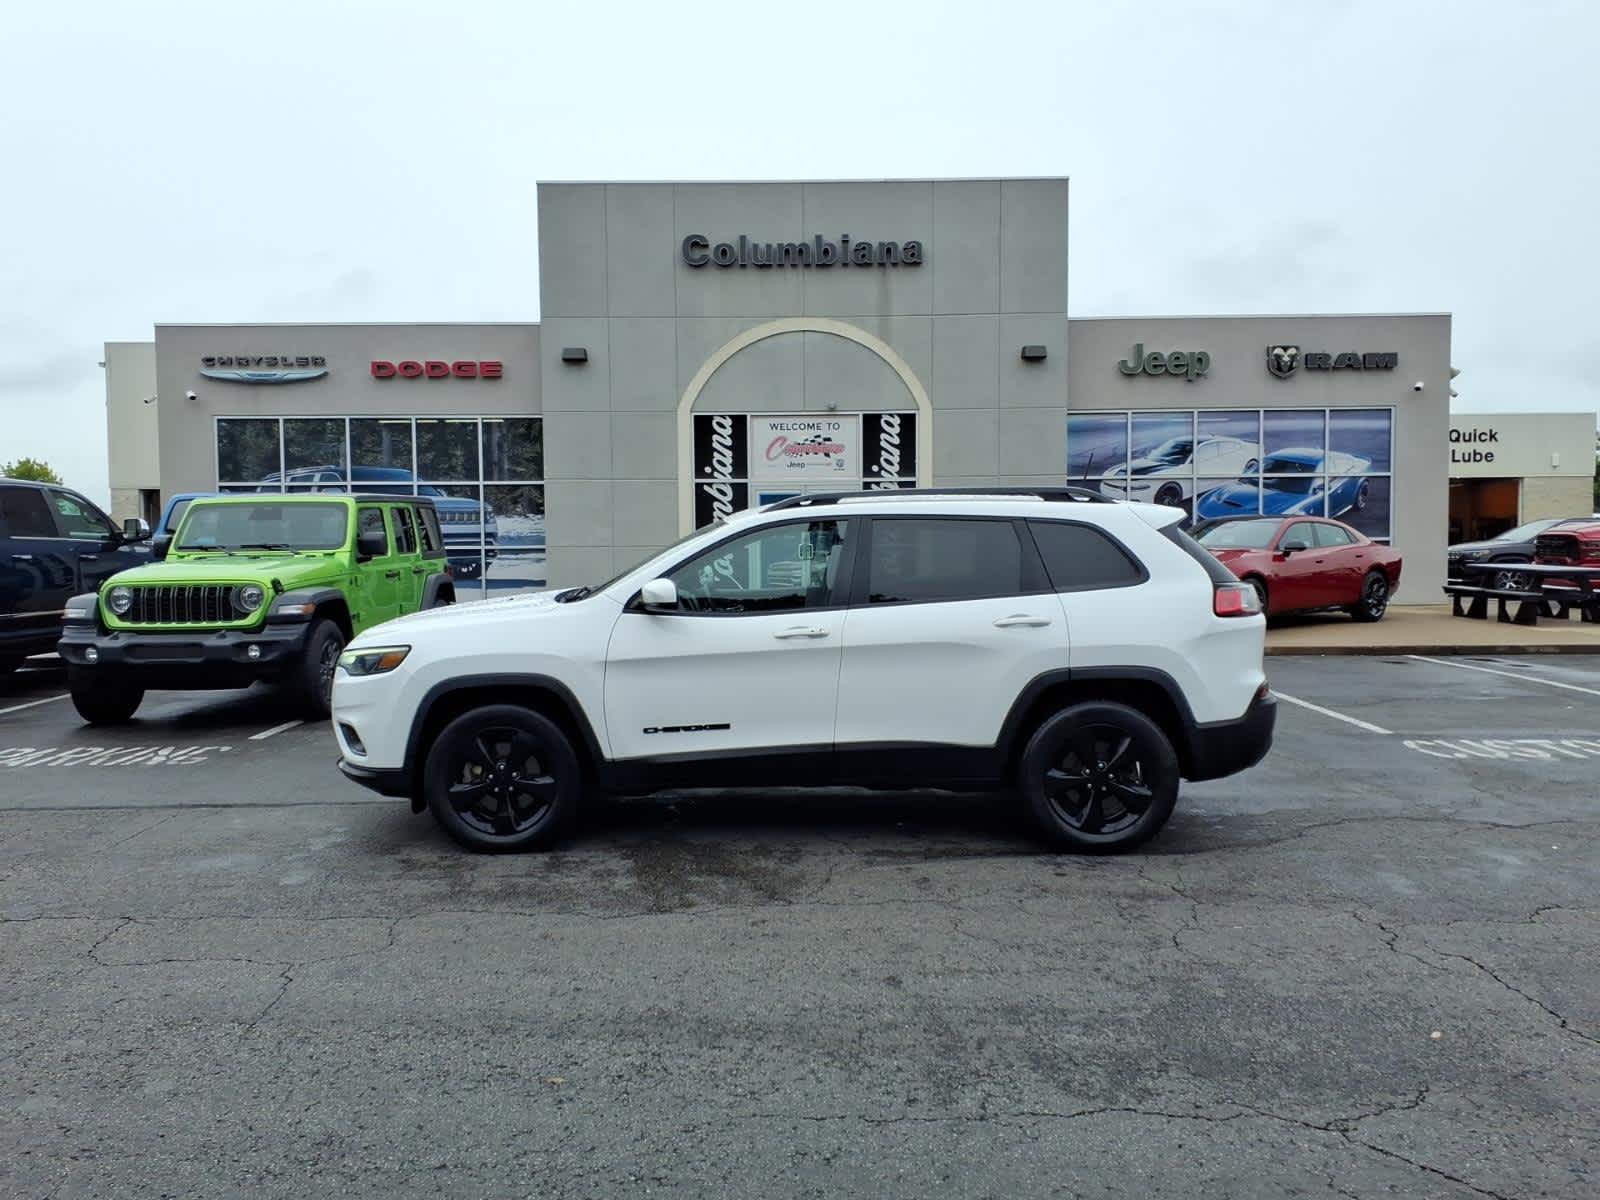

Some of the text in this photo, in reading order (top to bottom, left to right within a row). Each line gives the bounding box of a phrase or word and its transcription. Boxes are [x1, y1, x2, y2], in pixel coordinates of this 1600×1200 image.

[682, 234, 923, 268] Columbiana
[201, 356, 326, 367] CHRYSLER
[370, 360, 503, 379] DODGE
[1119, 343, 1210, 382] Jeep
[1304, 352, 1399, 371] RAM
[769, 422, 841, 431] WELCOME TO
[1449, 428, 1498, 443] Quick
[1451, 449, 1494, 463] Lube
